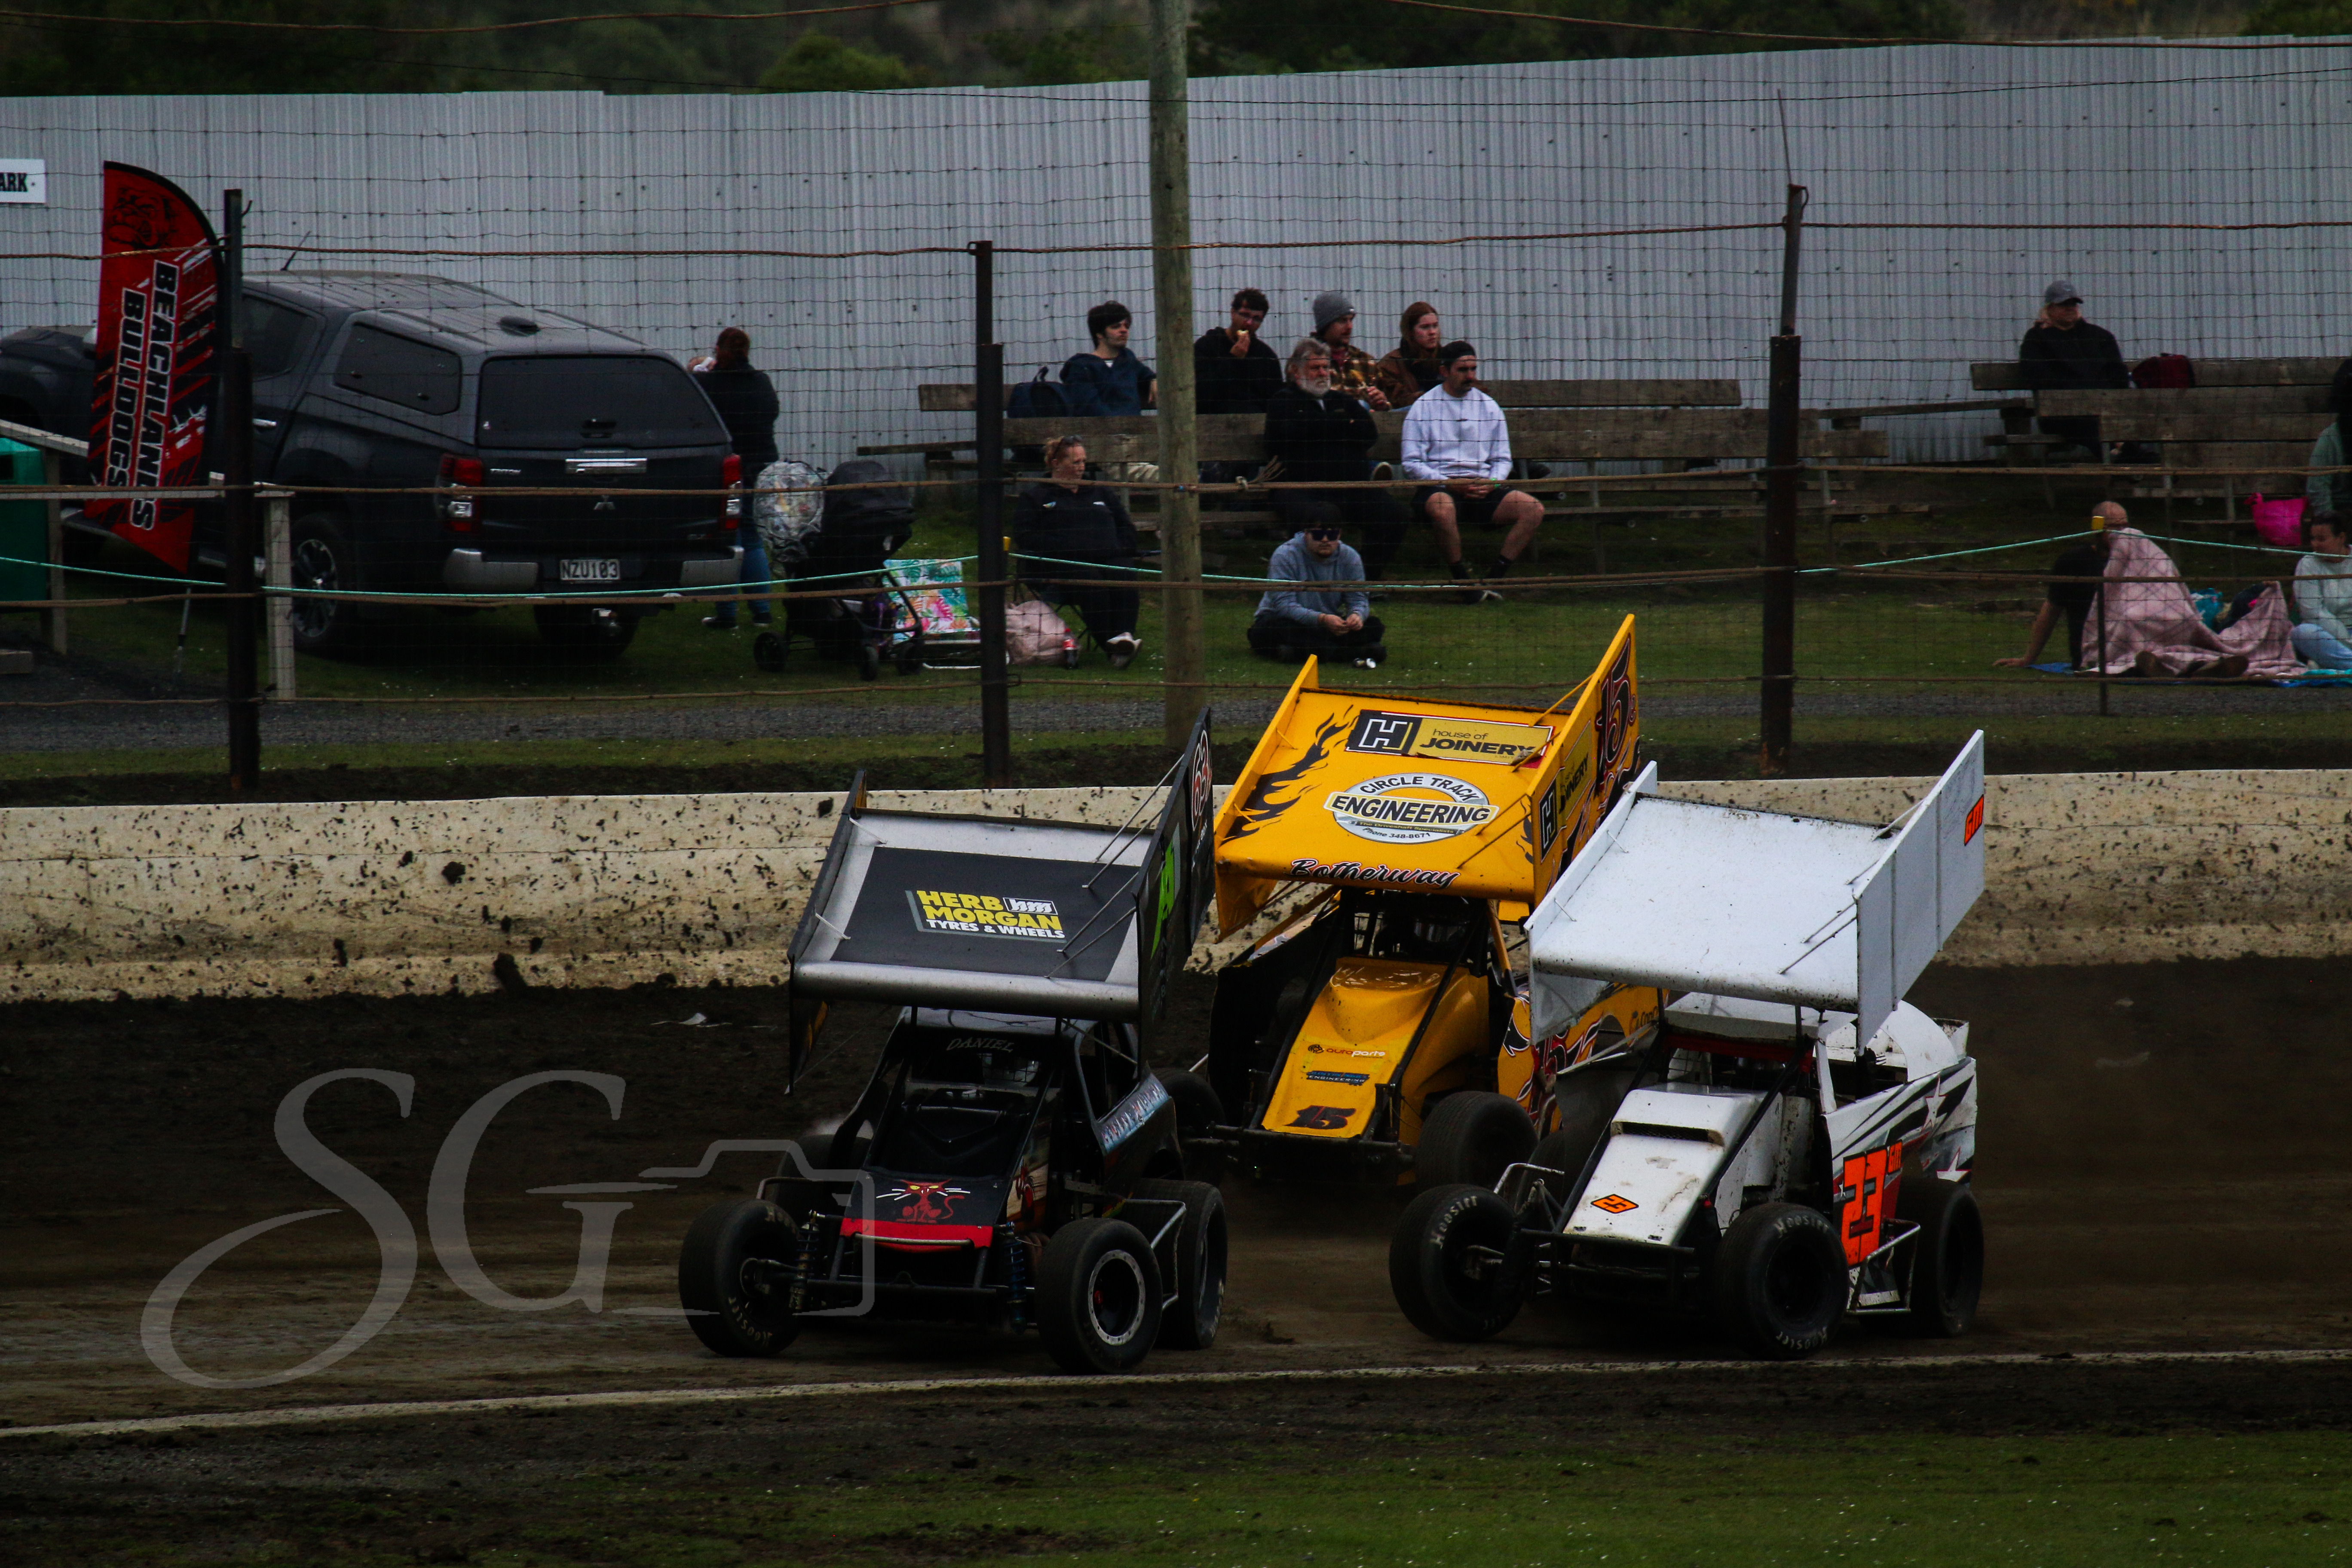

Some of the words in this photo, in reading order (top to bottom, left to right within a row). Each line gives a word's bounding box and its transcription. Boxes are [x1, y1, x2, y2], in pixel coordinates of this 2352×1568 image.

[563, 562, 617, 578] NZU103
[1433, 729, 1472, 739] house
[1420, 738, 1535, 756] JOINERY
[1360, 776, 1423, 793] CIRCLE
[1430, 777, 1481, 802] TRACK
[1331, 796, 1491, 824] ENGINEERING
[1363, 827, 1387, 837] Phone
[1284, 858, 1461, 889] Botherway
[916, 890, 1004, 911] HERB
[922, 905, 1063, 931] MORGAN
[926, 919, 980, 932] TYRES
[998, 925, 1066, 939] WHEELS
[946, 1037, 1015, 1053] DANIEL
[1326, 1048, 1386, 1057] autoparts
[1309, 1075, 1366, 1083] ENGINEERING
[1283, 1105, 1357, 1130] 15
